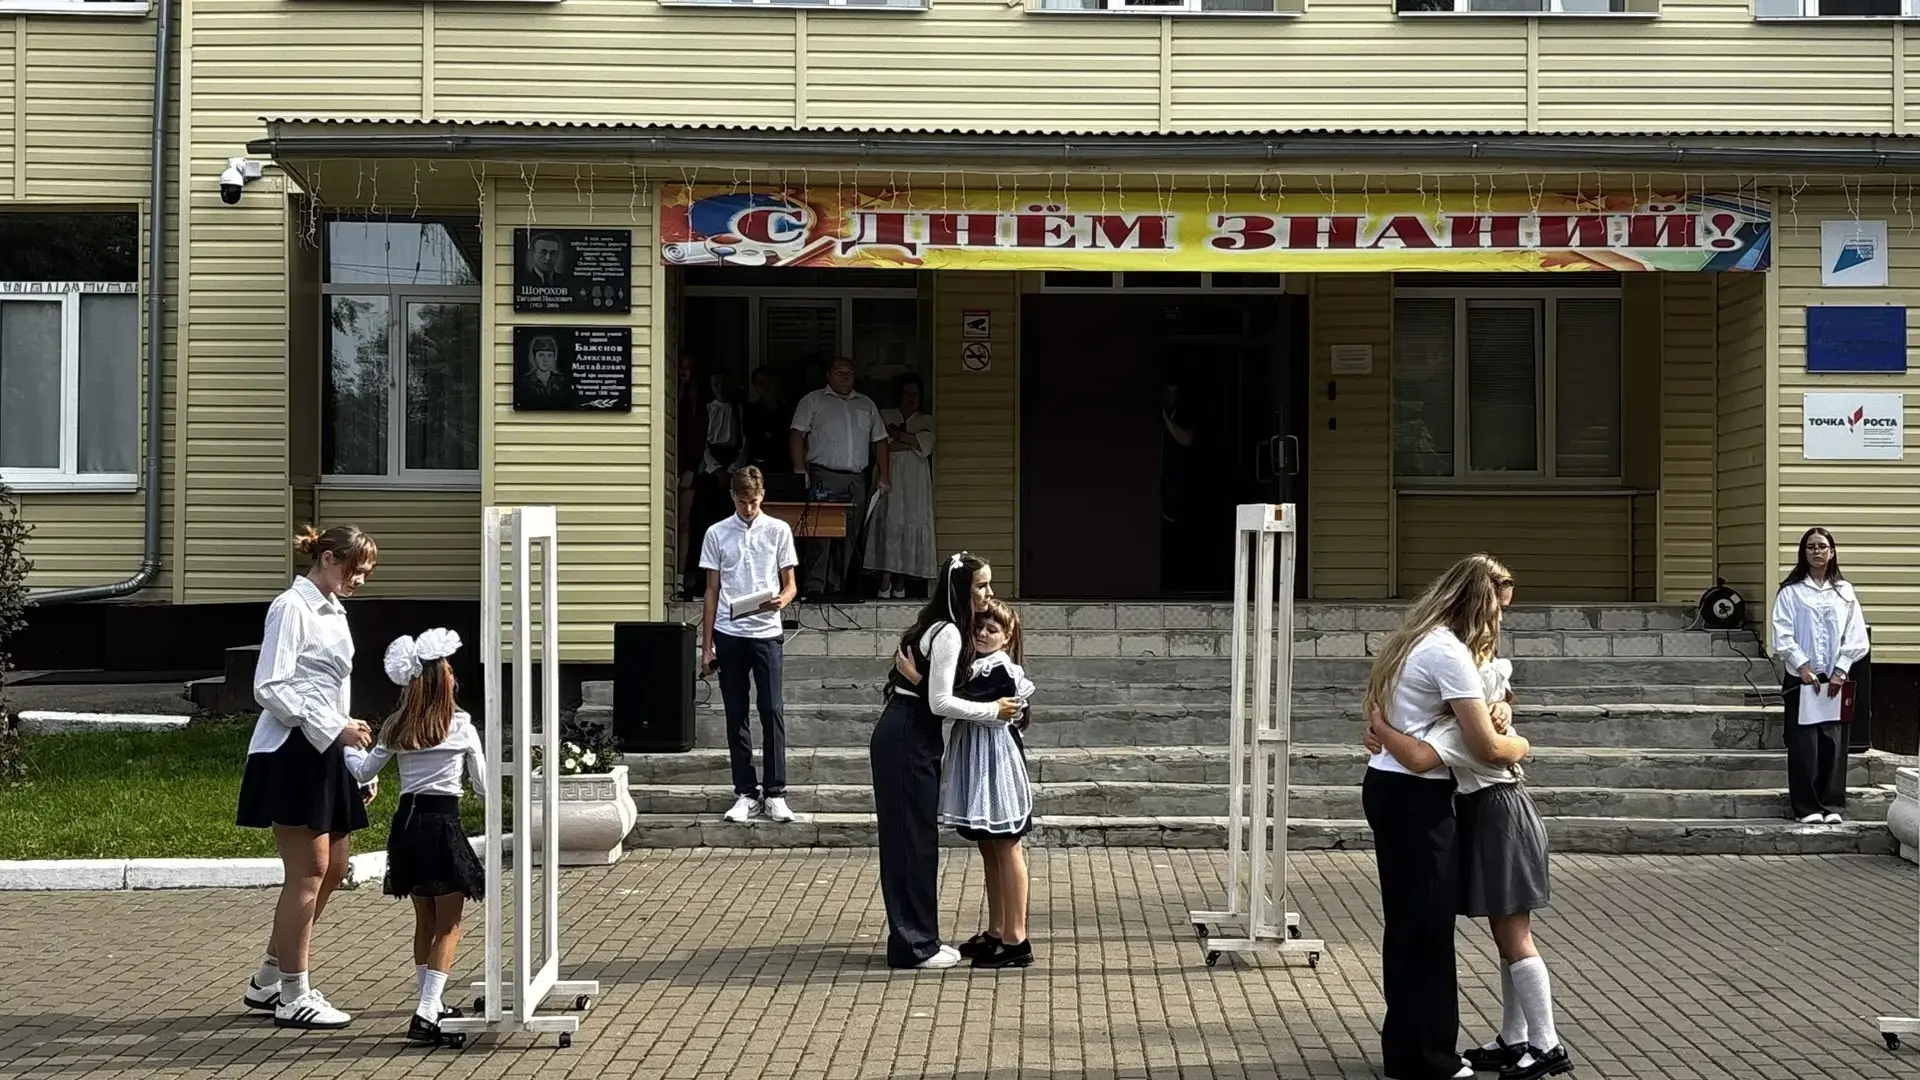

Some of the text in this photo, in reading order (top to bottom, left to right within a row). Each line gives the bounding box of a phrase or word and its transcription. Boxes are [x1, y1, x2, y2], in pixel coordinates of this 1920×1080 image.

[736, 203, 1740, 256] С ДНЁМ ЗНАНИЙ!
[575, 343, 623, 352] Баженов
[576, 353, 622, 363] Александр
[571, 362, 626, 370] Михайлович
[1808, 418, 1898, 427] ТОЧКА РОСТА
